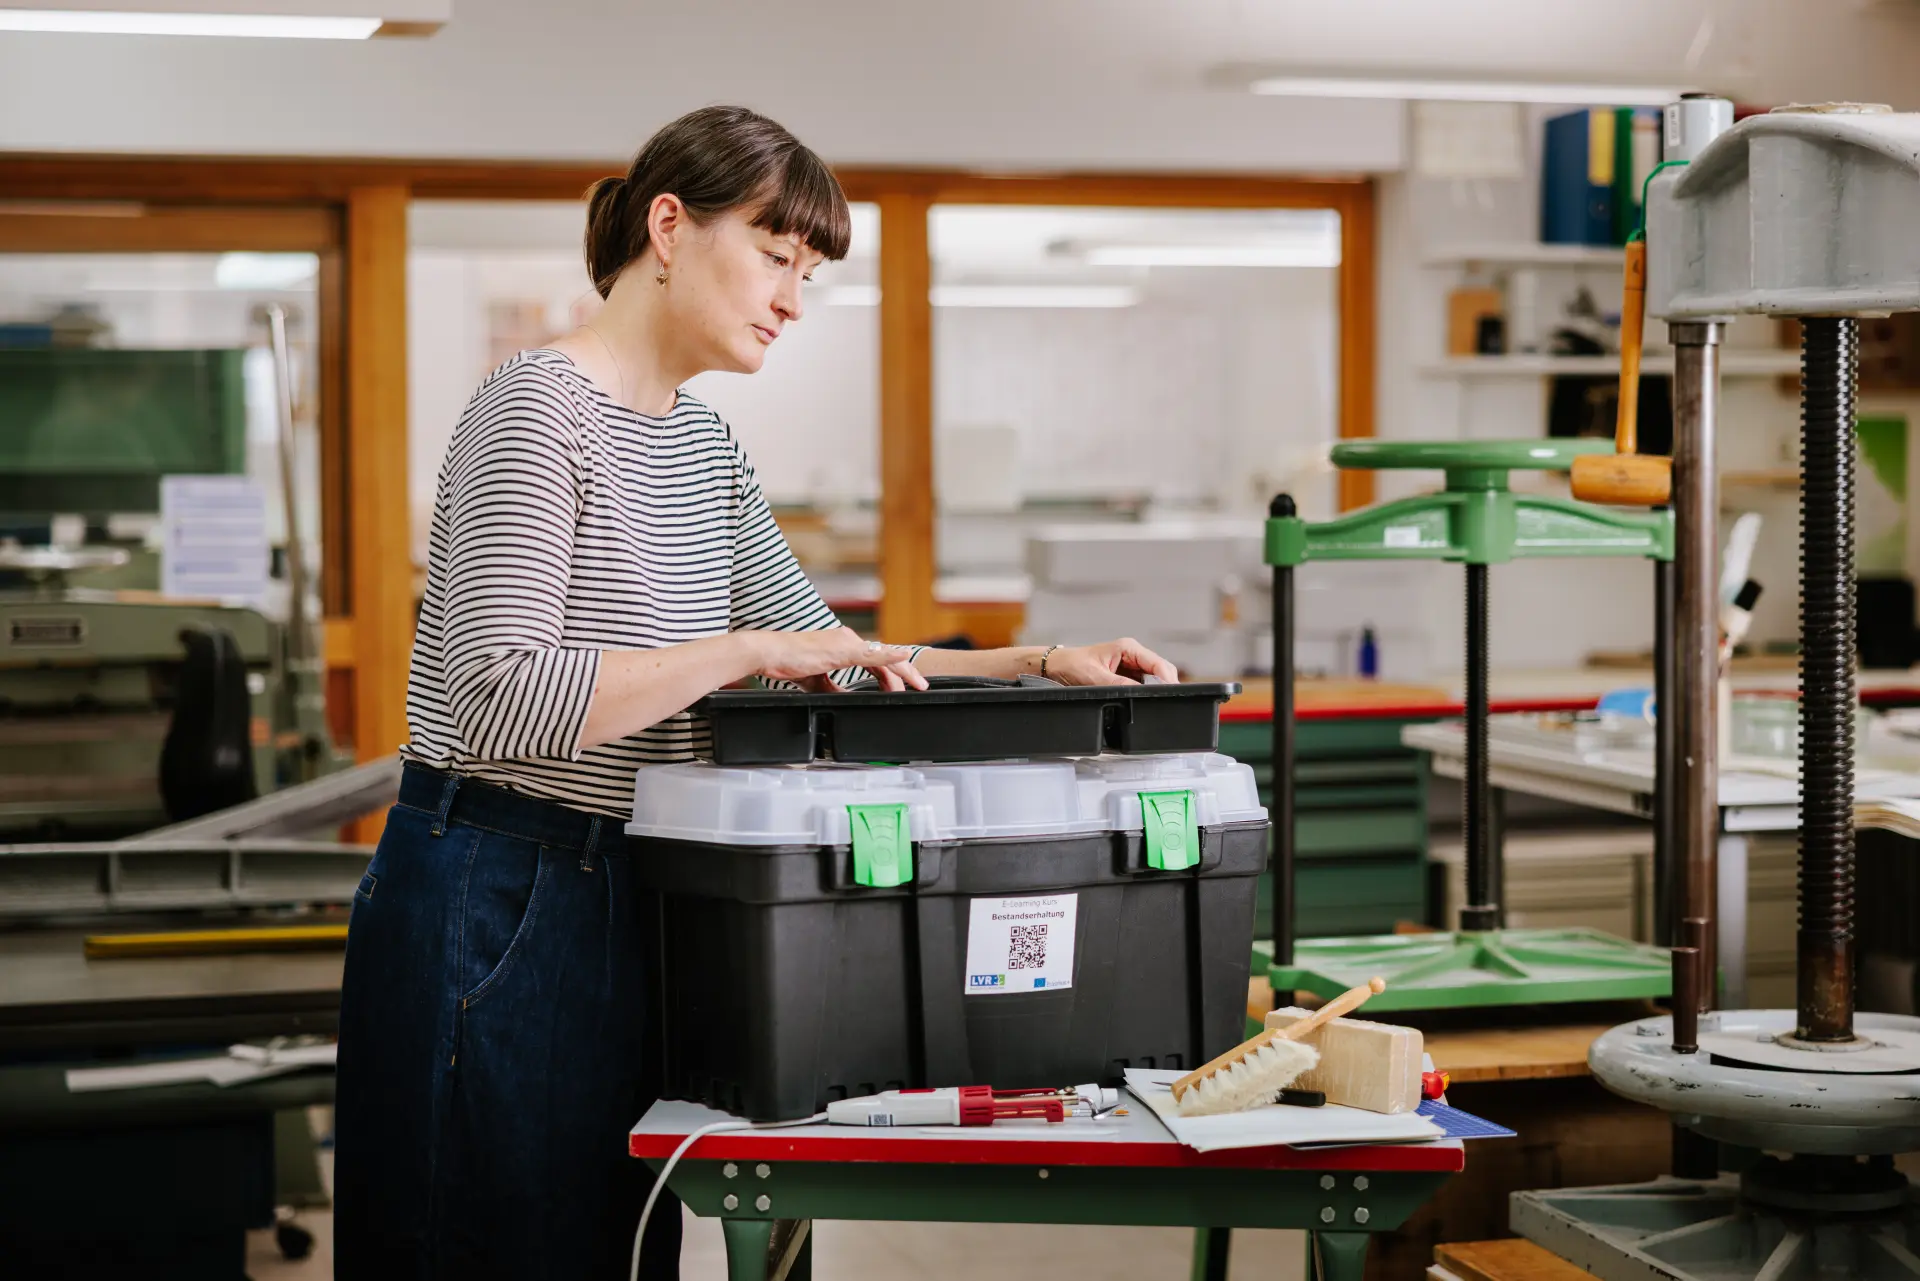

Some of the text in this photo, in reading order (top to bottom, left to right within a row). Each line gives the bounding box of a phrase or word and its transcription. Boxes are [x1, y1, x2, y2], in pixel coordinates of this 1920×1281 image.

[1002, 900, 1040, 908] E-Learning
[992, 911, 1065, 920] Bestandserhaltung
[971, 975, 992, 986] LVR
